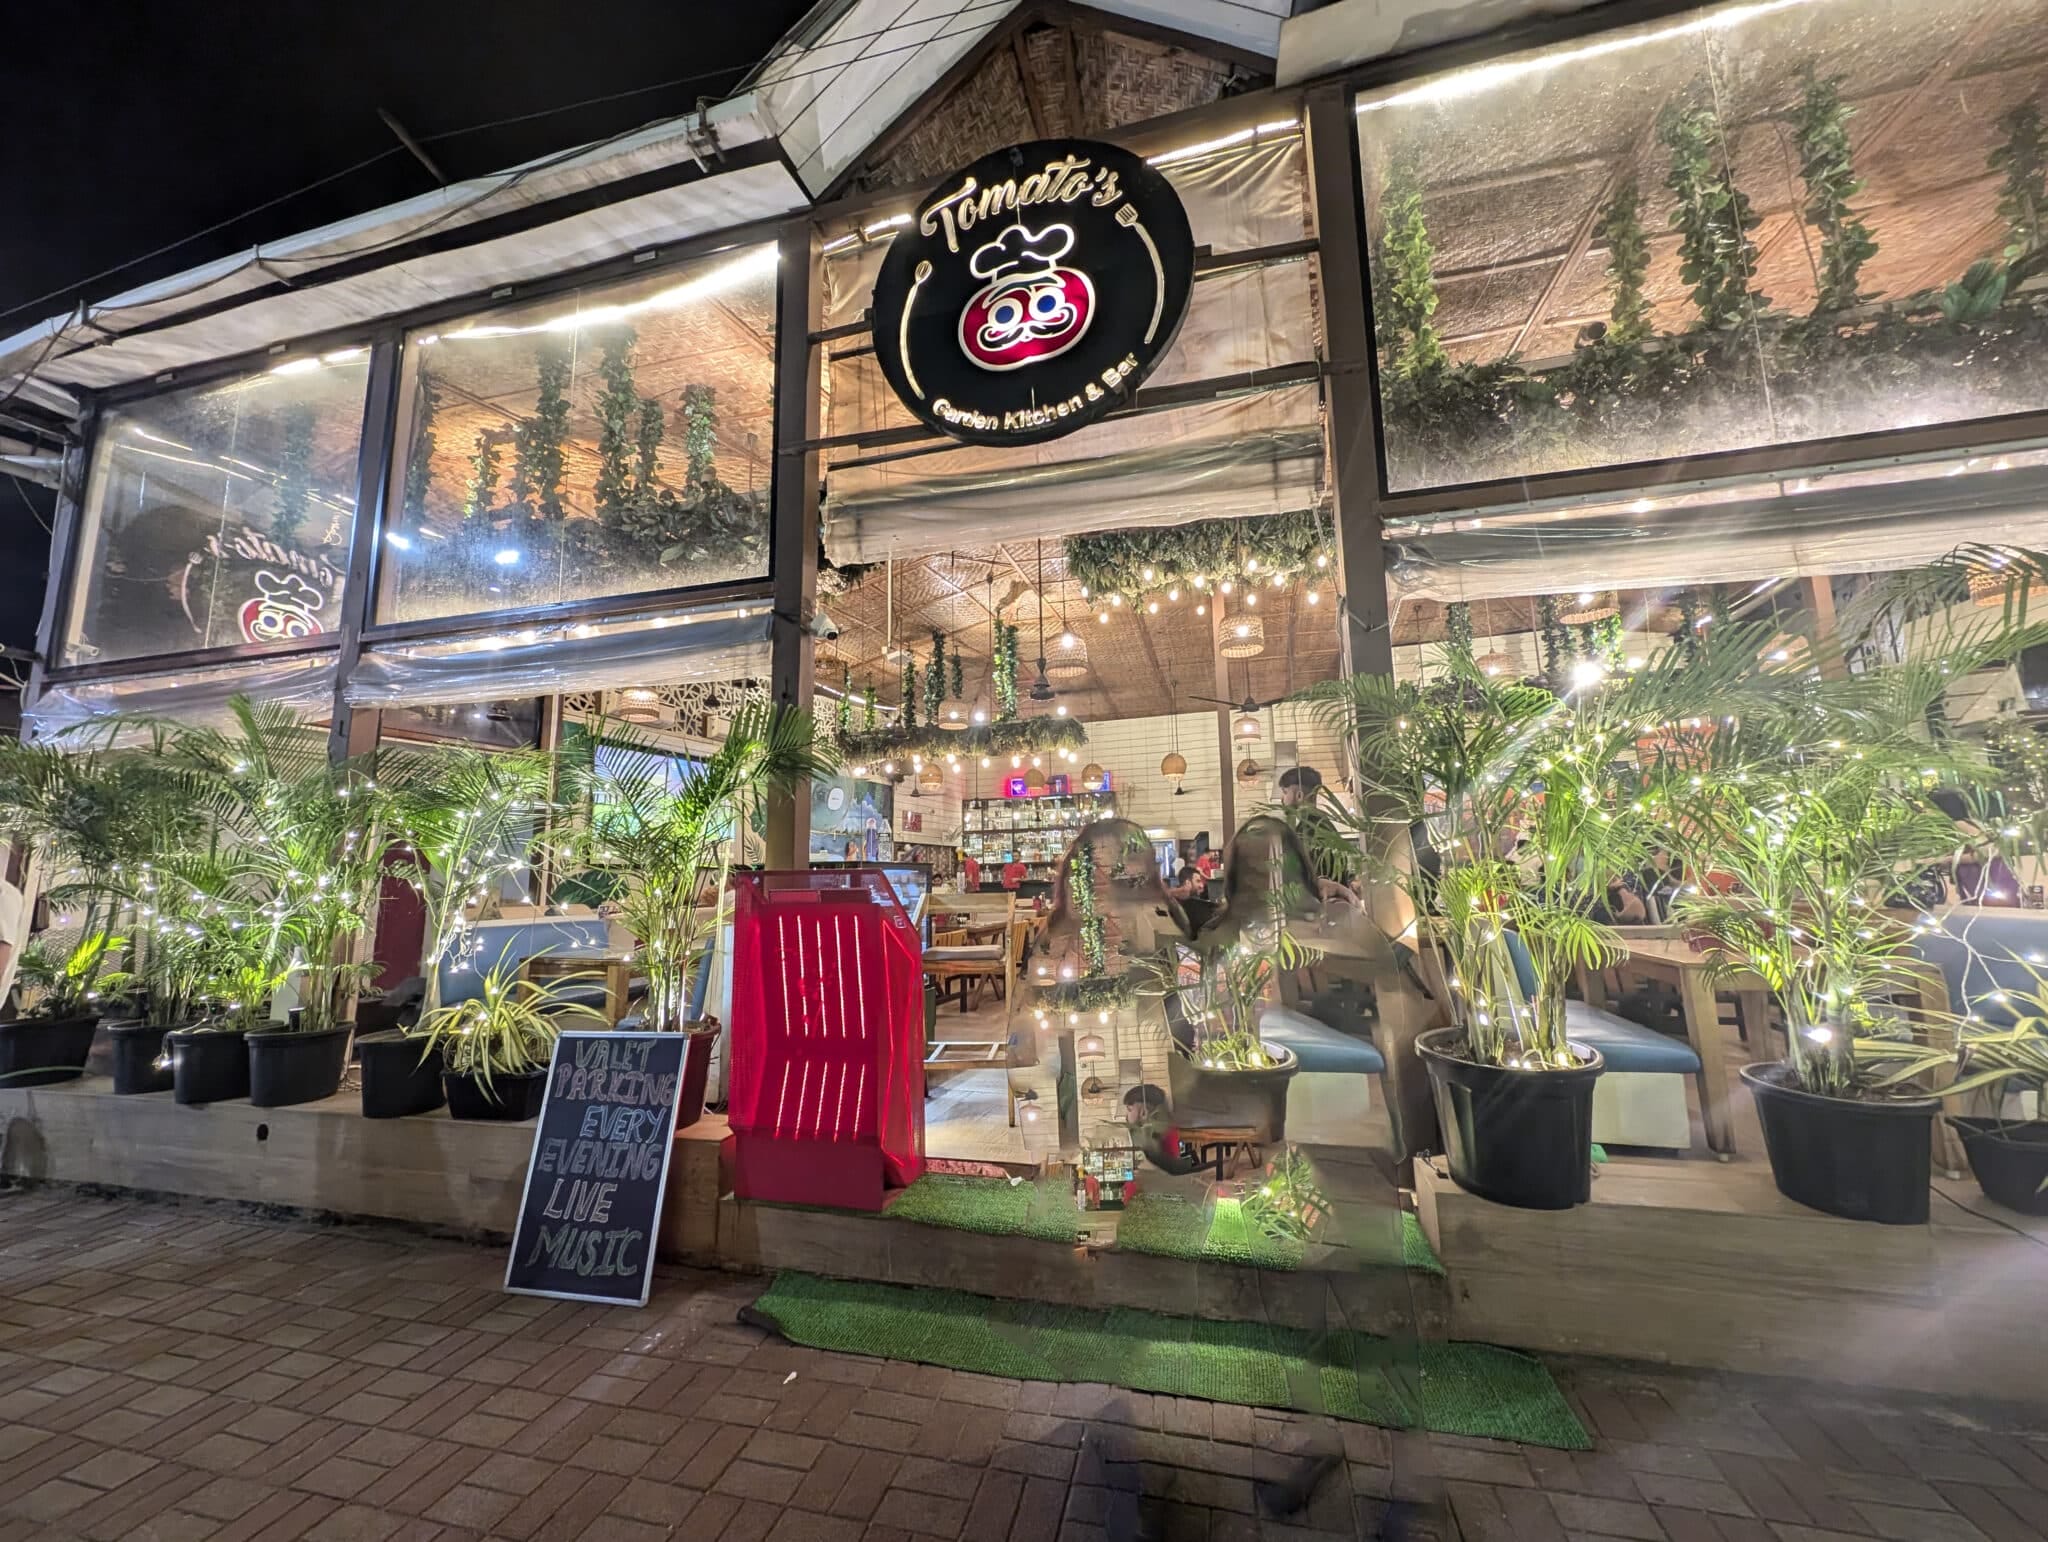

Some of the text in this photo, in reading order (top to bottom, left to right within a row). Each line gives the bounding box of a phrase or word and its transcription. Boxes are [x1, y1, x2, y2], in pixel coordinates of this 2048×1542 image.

[920, 154, 1123, 252] Tomato's
[932, 398, 999, 431] Garden
[1003, 395, 1083, 431] Kitchen
[1084, 382, 1104, 402] &
[575, 1039, 657, 1071] VALET
[555, 1063, 677, 1105] PARKING
[579, 1105, 667, 1144] EVERY
[536, 1137, 664, 1181] EVENING
[543, 1178, 617, 1224] LIVE
[525, 1223, 643, 1277] MUSIC
